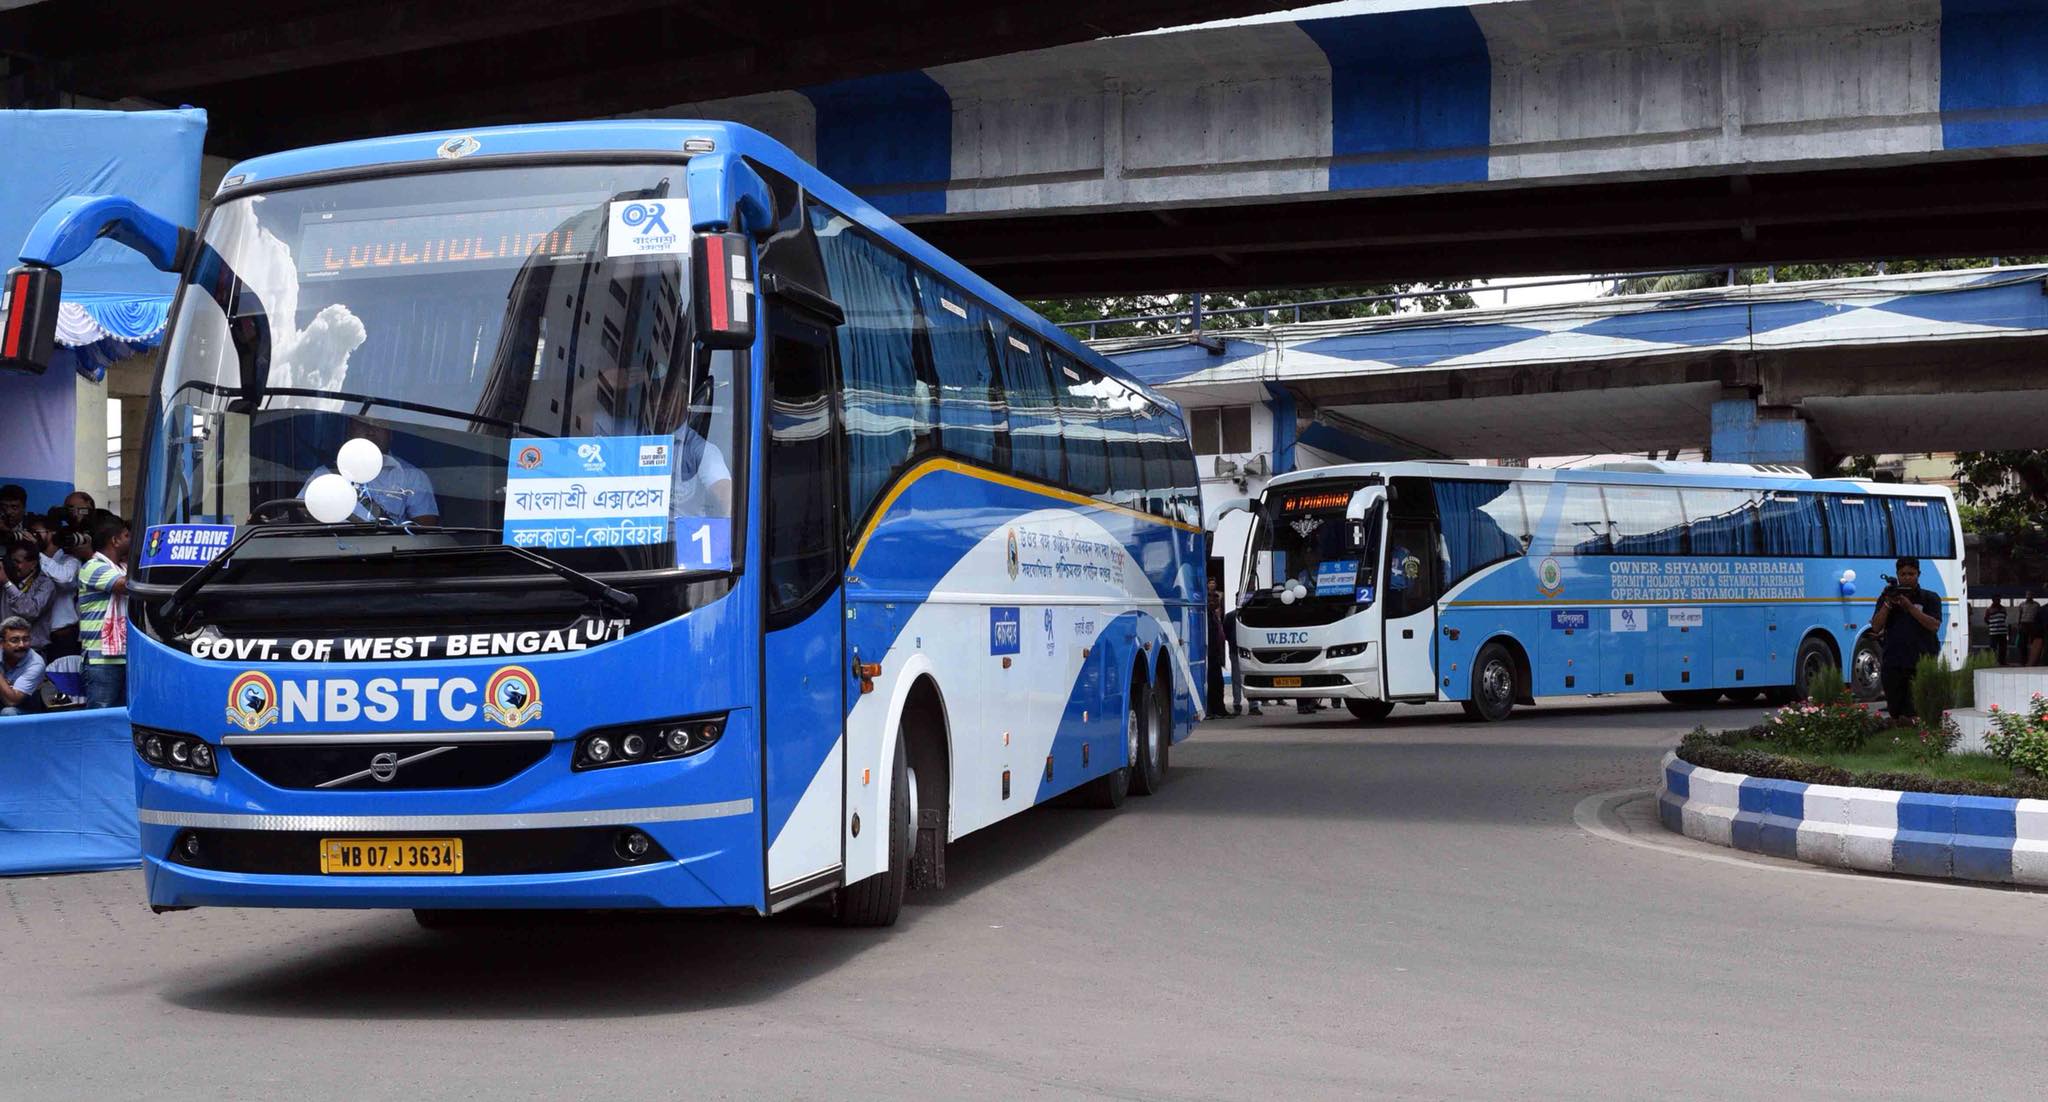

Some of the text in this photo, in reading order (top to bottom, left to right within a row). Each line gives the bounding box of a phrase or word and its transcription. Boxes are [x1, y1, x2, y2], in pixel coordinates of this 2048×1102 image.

[514, 484, 664, 511] বাংলাশ্রী এক্সপ্রেস
[168, 530, 229, 546] SAFE DRIVE
[691, 524, 713, 564] 1
[170, 546, 199, 560] SAVE
[1610, 561, 1804, 575] OWNER- SHYAMOLI PARIBAHAN
[1611, 575, 1645, 588] PERMIT
[1718, 575, 1758, 588] SHYAMOLI
[1760, 575, 1804, 588] PARIBAHAN
[1360, 588, 1370, 601] 2
[1611, 588, 1670, 601] OPERATED
[1691, 588, 1745, 600] SHYAMOLI
[1747, 587, 1805, 600] PARIBAHAN
[586, 619, 631, 641] U/T
[1266, 631, 1309, 645] W.B.T.C
[191, 628, 587, 661] GOVT. OF WEST BENGAL
[281, 677, 478, 723] NBSTC
[341, 846, 452, 867] WB 07 J 3634
